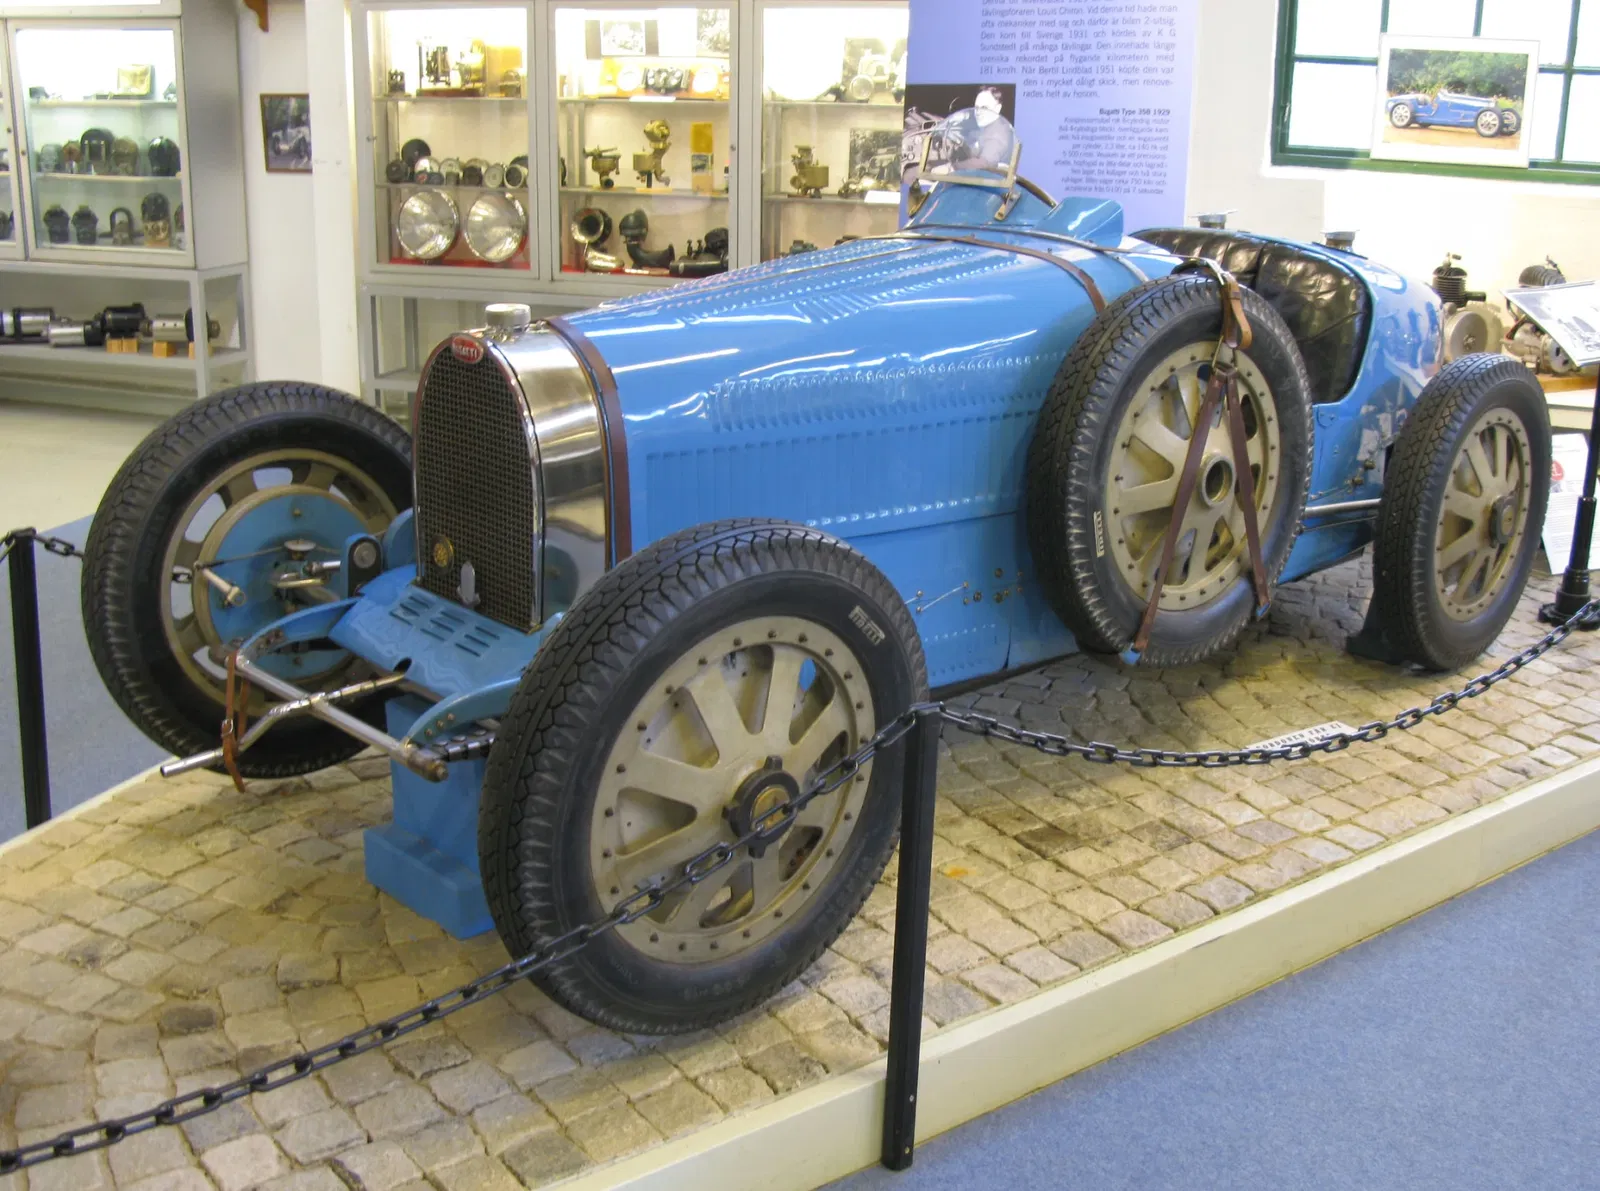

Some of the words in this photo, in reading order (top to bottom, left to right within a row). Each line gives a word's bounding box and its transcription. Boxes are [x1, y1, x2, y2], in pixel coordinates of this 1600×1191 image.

[1037, 7, 1056, 16] Louis
[1087, 6, 1098, 14] Vid
[1100, 5, 1123, 13] denna
[1125, 4, 1136, 12] tid
[1137, 4, 1157, 12] hade
[981, 20, 994, 28] ofta
[998, 20, 1036, 28] mekaniker
[1039, 19, 1056, 27] med
[1058, 20, 1069, 28] sig
[1072, 18, 1085, 26] och
[1122, 16, 1140, 24] bilen
[980, 31, 995, 40] Den
[1000, 31, 1016, 39] kom
[1021, 30, 1031, 38] till
[1036, 30, 1063, 40] Sverige
[1068, 30, 1088, 38] 1931
[1093, 29, 1106, 38] och
[1158, 28, 1164, 36] K
[1169, 28, 1176, 36] G
[1020, 42, 1029, 52] på
[1032, 41, 1058, 52] många
[1096, 41, 1111, 50] Den
[1114, 40, 1150, 50] innehade
[1154, 40, 1176, 51] länge
[980, 54, 1008, 63] svenska
[1016, 54, 1048, 62] rekordet
[1054, 54, 1064, 63] på
[1070, 54, 1100, 64] flygande
[1107, 52, 1149, 62] kilometern
[1156, 52, 1174, 62] med
[980, 66, 992, 74] 181
[1038, 65, 1059, 74] Bertil
[1062, 66, 1092, 74] Lindblad
[1096, 64, 1114, 74] 1951
[1142, 65, 1158, 74] den
[1023, 78, 1038, 86] den
[1046, 78, 1072, 88] mycket
[1076, 76, 1096, 88] dåligt
[1023, 90, 1043, 98] rades
[1046, 90, 1060, 98] helt
[1122, 108, 1136, 116] Type
[1154, 108, 1170, 116] 1929
[848, 605, 886, 646] PIRELLI
